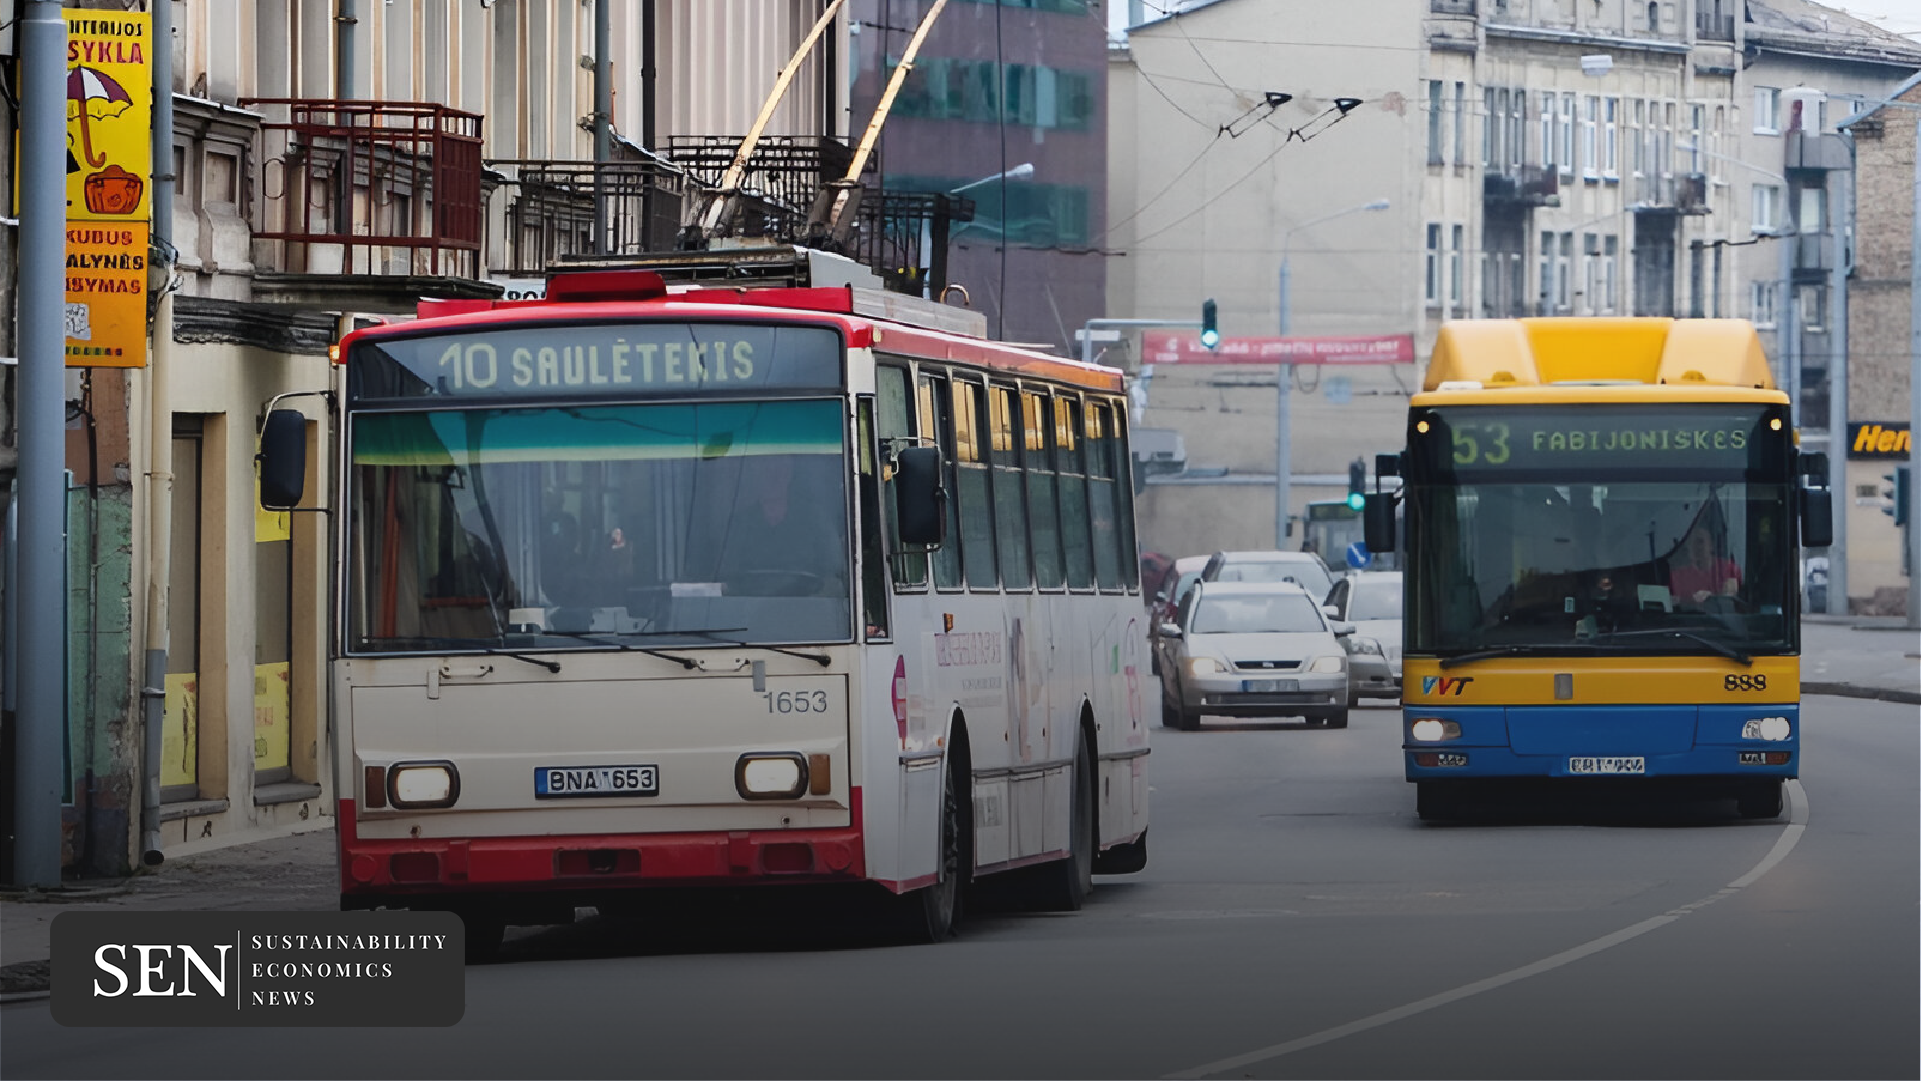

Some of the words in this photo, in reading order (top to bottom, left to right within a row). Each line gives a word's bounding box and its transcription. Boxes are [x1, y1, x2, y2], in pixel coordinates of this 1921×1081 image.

[67, 40, 144, 64] SYKLA
[438, 342, 497, 389] 10
[513, 338, 754, 386] SAULĖTEKIS
[1450, 421, 1510, 464] 53
[1423, 676, 1474, 696] VVT
[763, 691, 828, 714] 1653
[550, 771, 597, 791] BNA
[612, 769, 652, 789] 653
